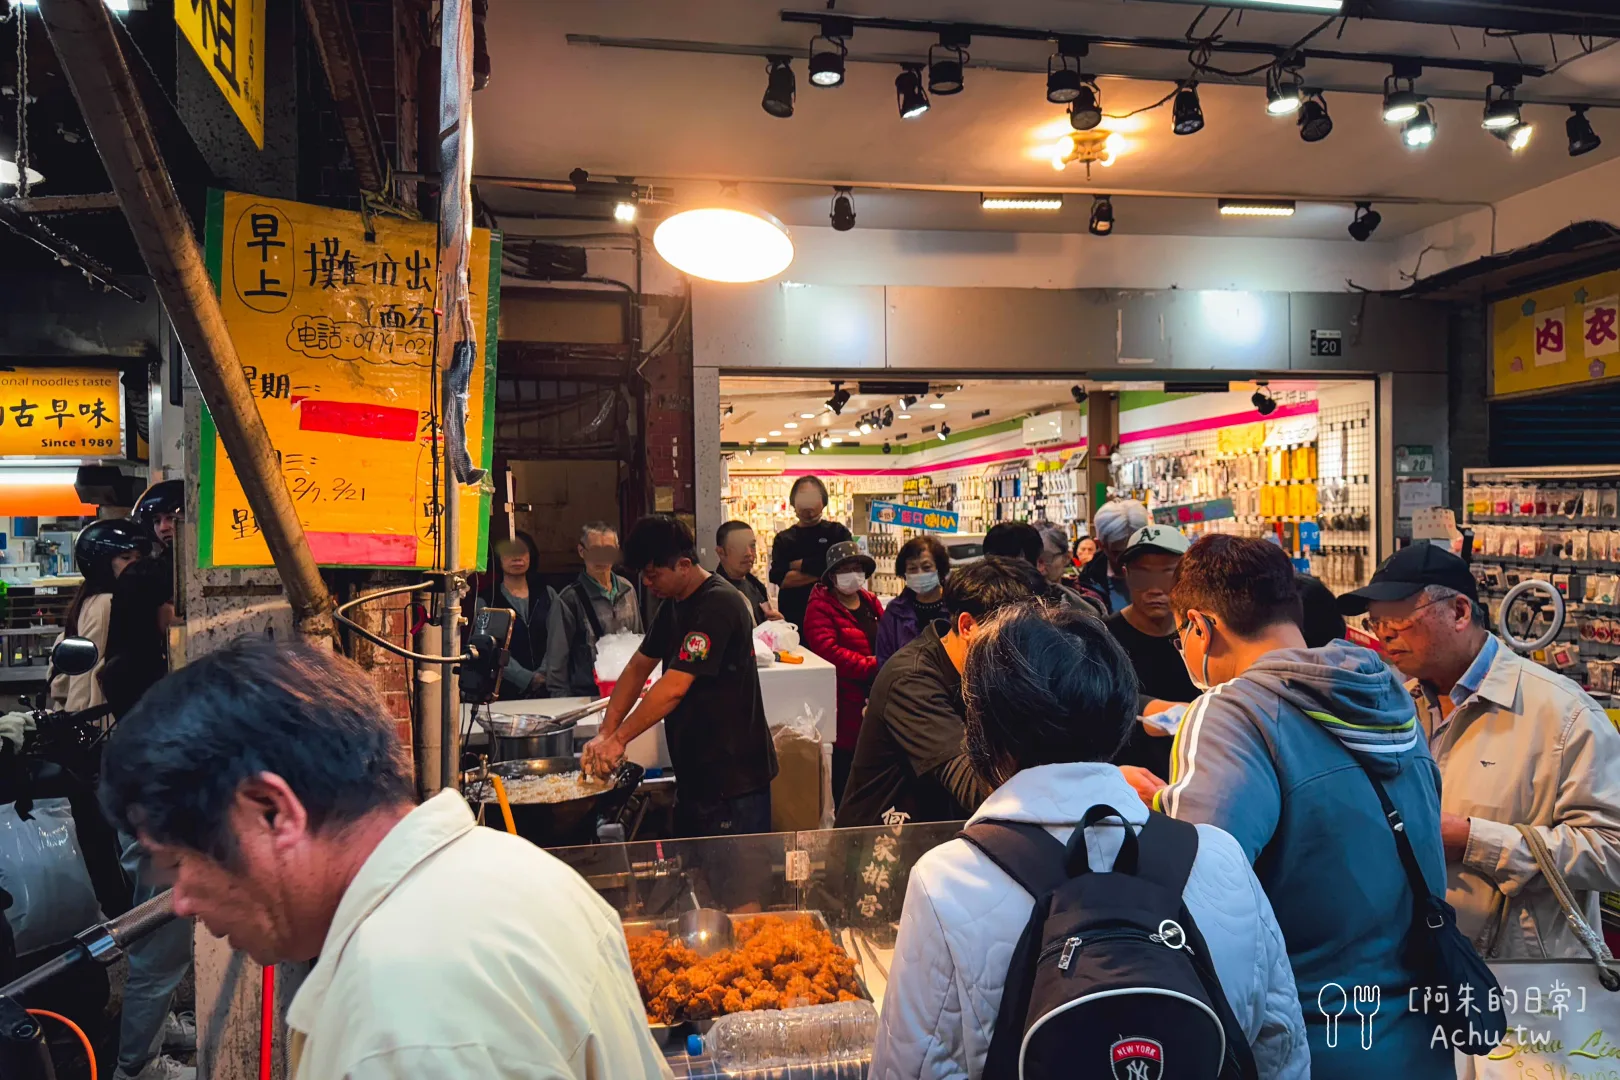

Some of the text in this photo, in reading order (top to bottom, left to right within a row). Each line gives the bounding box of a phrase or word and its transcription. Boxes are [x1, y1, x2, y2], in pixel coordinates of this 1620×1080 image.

[244, 213, 288, 297] 早上
[1320, 340, 1337, 353] 20
[31, 377, 80, 387] noodles
[82, 377, 112, 387] taste
[41, 438, 114, 448] Since 1989
[1412, 459, 1427, 472] 20
[1117, 1044, 1156, 1057] NEW YORK
